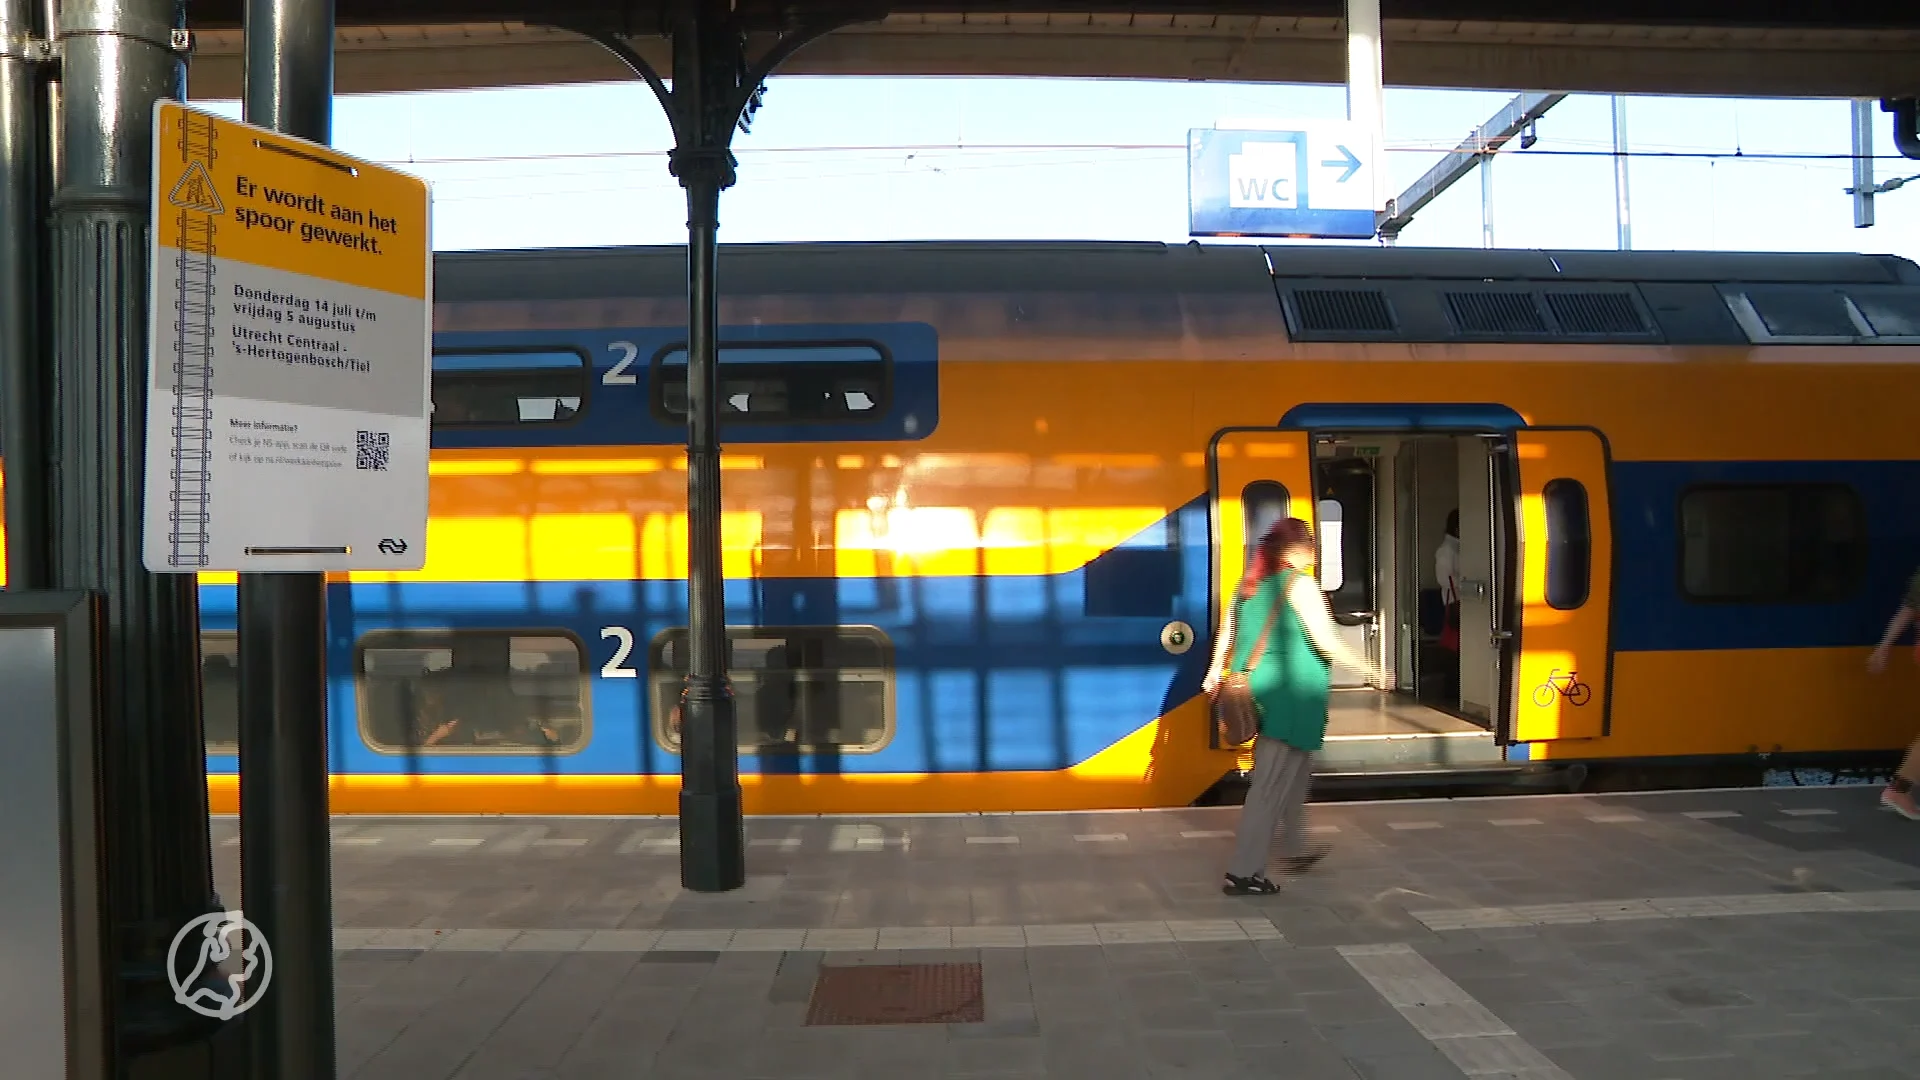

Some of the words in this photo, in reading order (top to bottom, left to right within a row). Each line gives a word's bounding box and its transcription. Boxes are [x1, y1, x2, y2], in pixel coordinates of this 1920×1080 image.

[237, 175, 257, 197] Er
[263, 186, 326, 216] wordt
[330, 204, 363, 225] aan
[369, 209, 397, 233] het
[1238, 178, 1289, 200] WC
[235, 207, 295, 233] spoor
[300, 222, 382, 255] gewerkt.
[233, 303, 282, 323] vrijdag
[287, 310, 294, 321] 5
[299, 315, 356, 333] augustus
[234, 284, 310, 311] Donderdag
[315, 299, 328, 311] 14
[332, 303, 351, 317] juli
[355, 309, 376, 321] t/m
[232, 340, 370, 372] 's-Hertogenbosch/Tiel
[233, 325, 282, 344] Utrecht
[287, 335, 340, 352] Centraal
[601, 341, 638, 386] 2
[600, 626, 637, 679] 2
